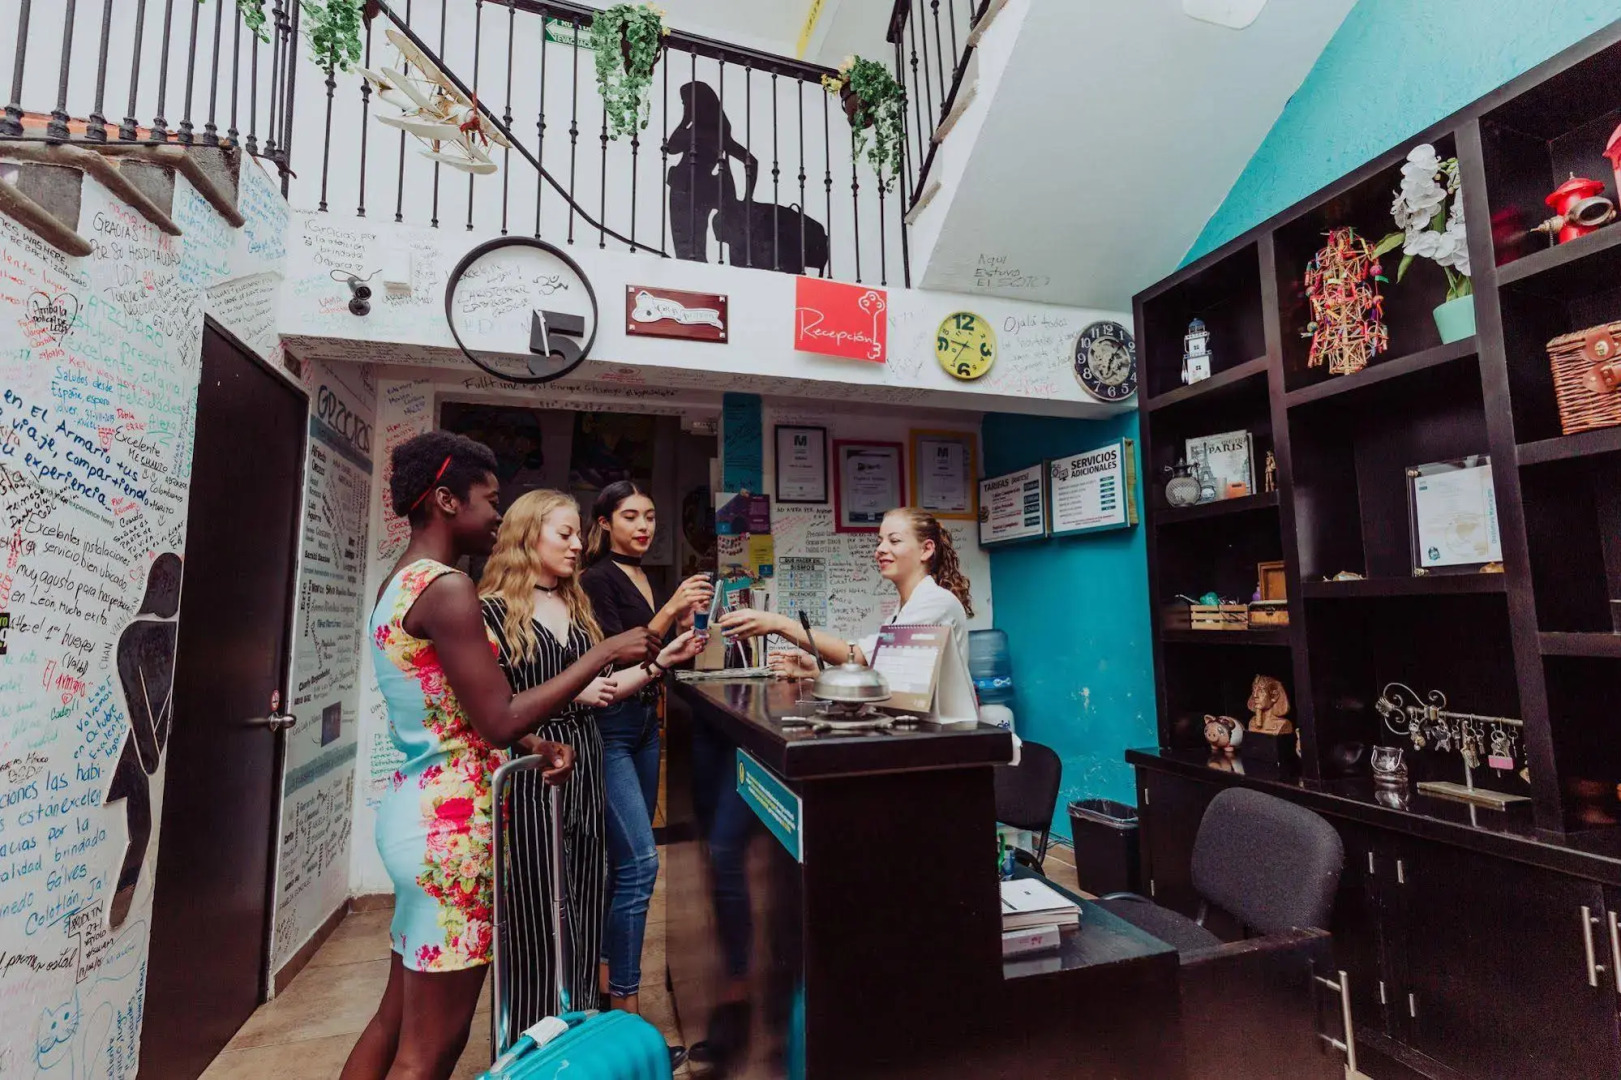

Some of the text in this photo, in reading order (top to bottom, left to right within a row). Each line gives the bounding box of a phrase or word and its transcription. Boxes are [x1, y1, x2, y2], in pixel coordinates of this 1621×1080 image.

[795, 307, 873, 346] Recepción
[952, 314, 975, 331] 12
[1091, 327, 1100, 339] 11
[1103, 324, 1114, 336] 12
[1119, 330, 1124, 340] 1
[1081, 337, 1091, 348] 10
[1128, 341, 1136, 353] 2
[980, 342, 992, 357] 3
[1077, 352, 1086, 364] 9
[957, 362, 971, 376] 6
[1083, 367, 1092, 379] 8
[1130, 372, 1137, 382] 4
[1093, 380, 1101, 392] 7
[1107, 386, 1116, 397] 6
[1121, 383, 1129, 394] 5
[4, 389, 23, 409] en
[30, 405, 48, 423] El
[55, 419, 111, 464] Armario
[1208, 442, 1244, 454] PARIS
[1071, 450, 1117, 470] SERVICIOS
[1071, 461, 1117, 478] ADICIONALES
[984, 478, 1009, 492] TARIFAS
